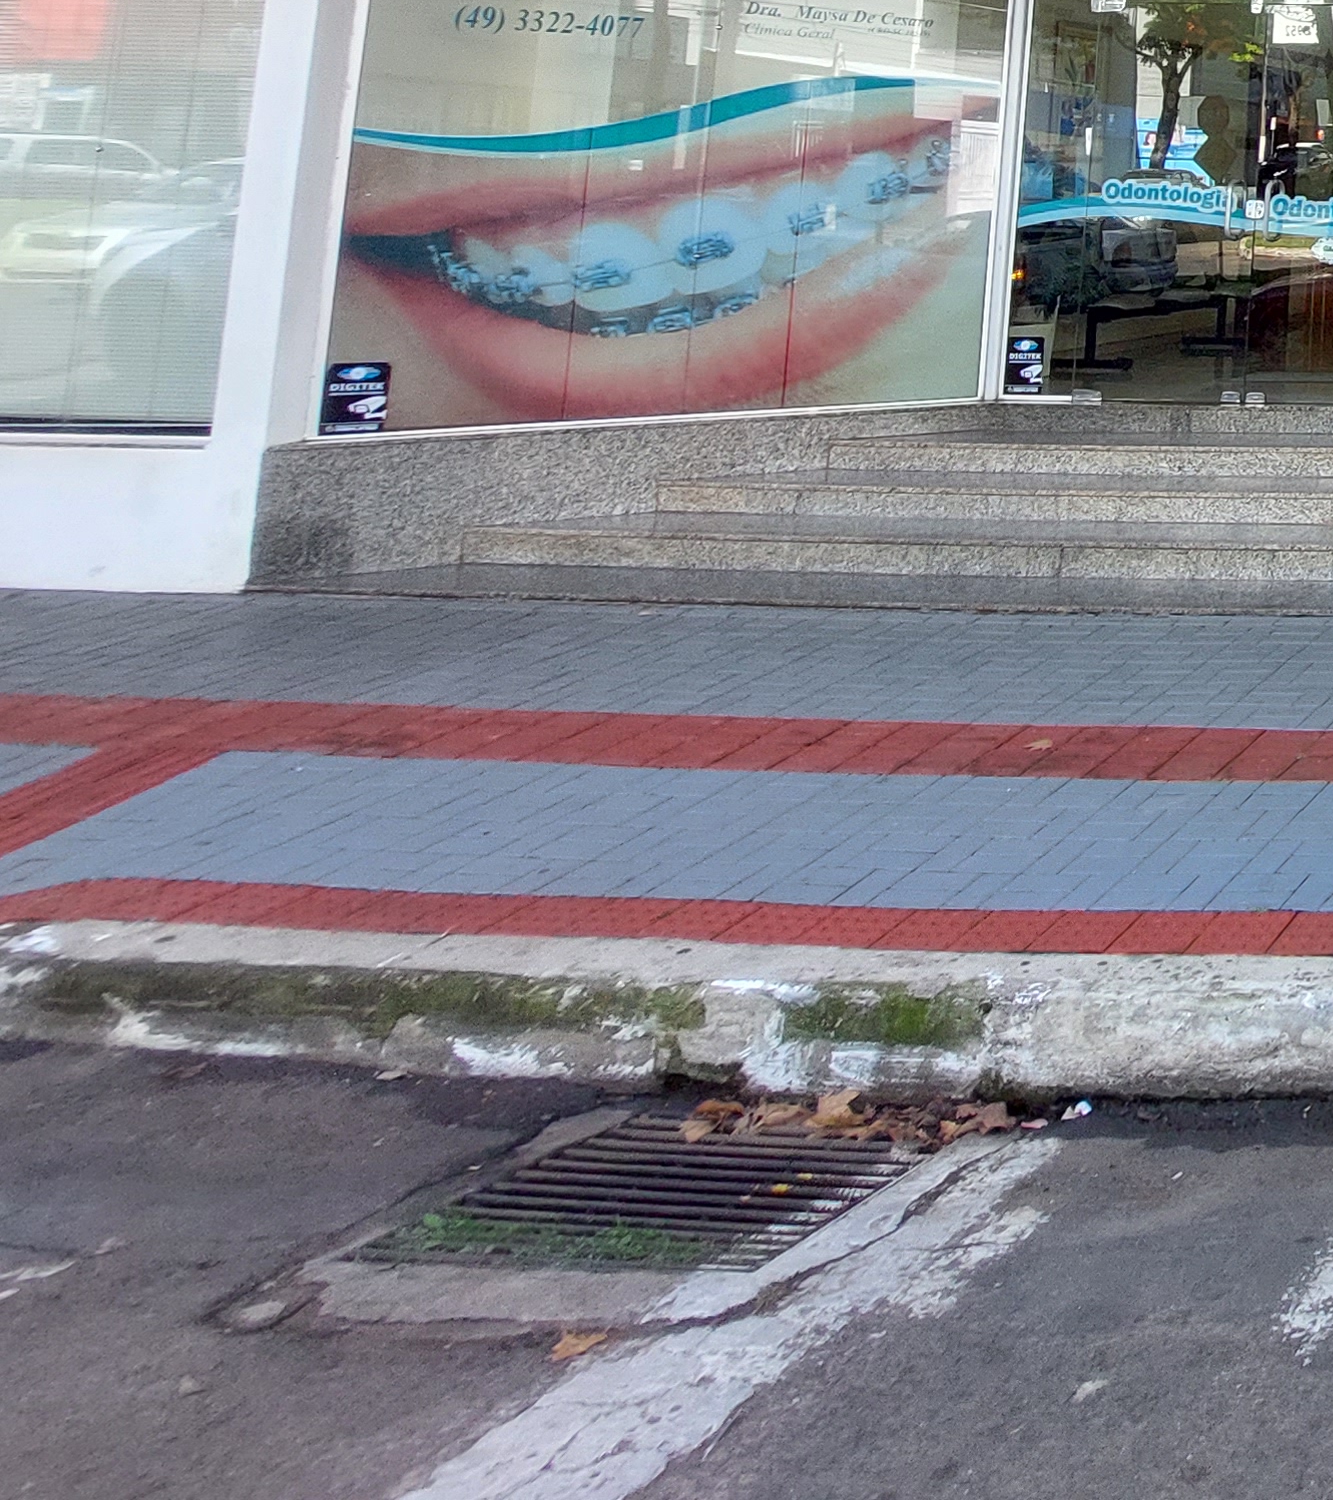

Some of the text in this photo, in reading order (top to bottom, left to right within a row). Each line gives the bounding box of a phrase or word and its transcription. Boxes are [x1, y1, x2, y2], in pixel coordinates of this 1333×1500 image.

[455, 5, 645, 38] (49) 3322-4077
[745, 2, 934, 29] Dra. Maysa De Cesaro
[797, 26, 836, 39] Geral
[329, 382, 385, 392] DIGITEK
